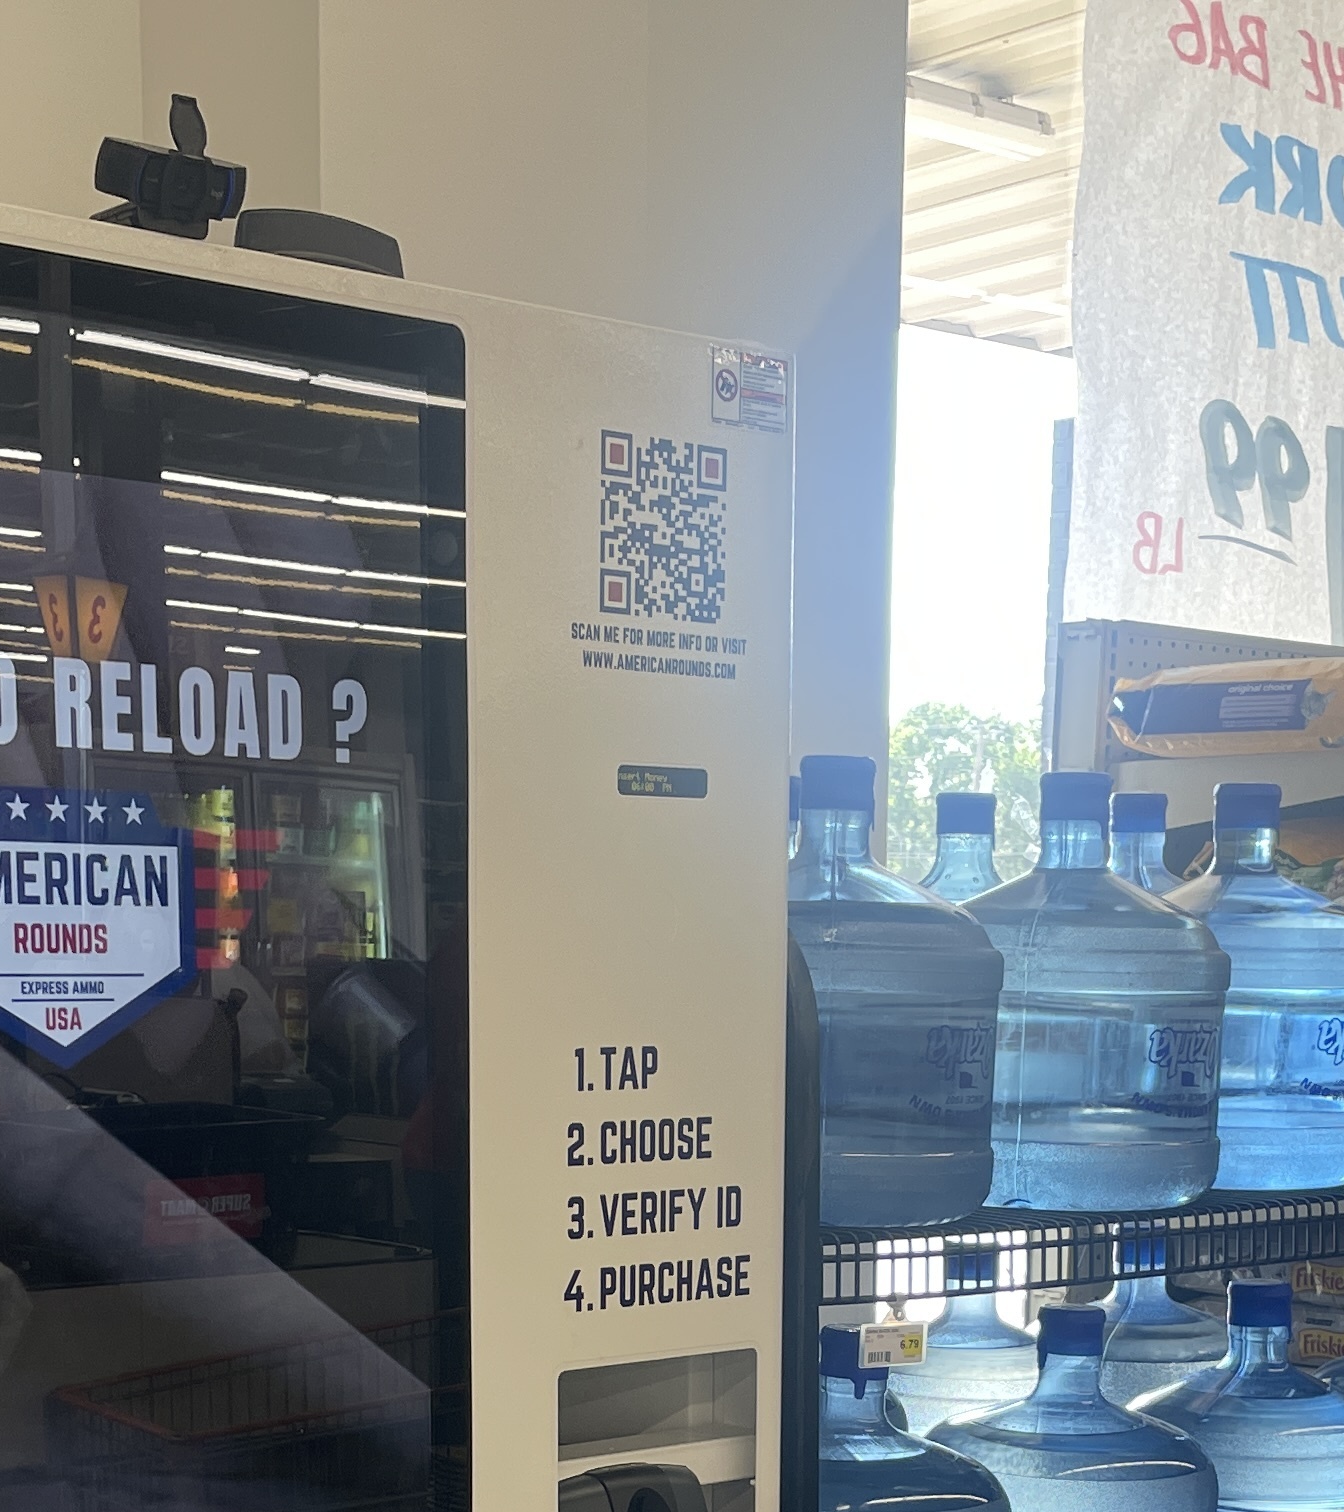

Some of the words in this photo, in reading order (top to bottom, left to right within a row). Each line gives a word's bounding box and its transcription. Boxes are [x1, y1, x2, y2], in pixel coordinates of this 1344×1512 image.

[570, 621, 601, 642] SCAN
[603, 625, 620, 644] ME
[622, 627, 644, 646] FOR
[646, 629, 676, 649] MORE
[678, 632, 702, 652] INFO
[705, 635, 718, 653] OR
[721, 636, 748, 656] VISIT
[582, 649, 737, 681] WWW.AMERICANROUNDS.COM
[53, 655, 305, 762] RELOAD
[332, 677, 369, 764] ?
[13, 921, 109, 956] ROUNDS
[19, 979, 71, 997] EXPRESS
[72, 979, 106, 997] AMMO
[44, 1006, 83, 1033] USA
[599, 1045, 659, 1091] TAP
[567, 1122, 594, 1168] 2.
[599, 1115, 713, 1167] CHOOSE
[567, 1195, 594, 1240] 3.
[599, 1187, 707, 1238] VERIFY
[716, 1185, 742, 1229] ID
[563, 1269, 594, 1313] 4.
[599, 1254, 751, 1310] PURCHASE
[899, 1338, 920, 1350] 6.79
